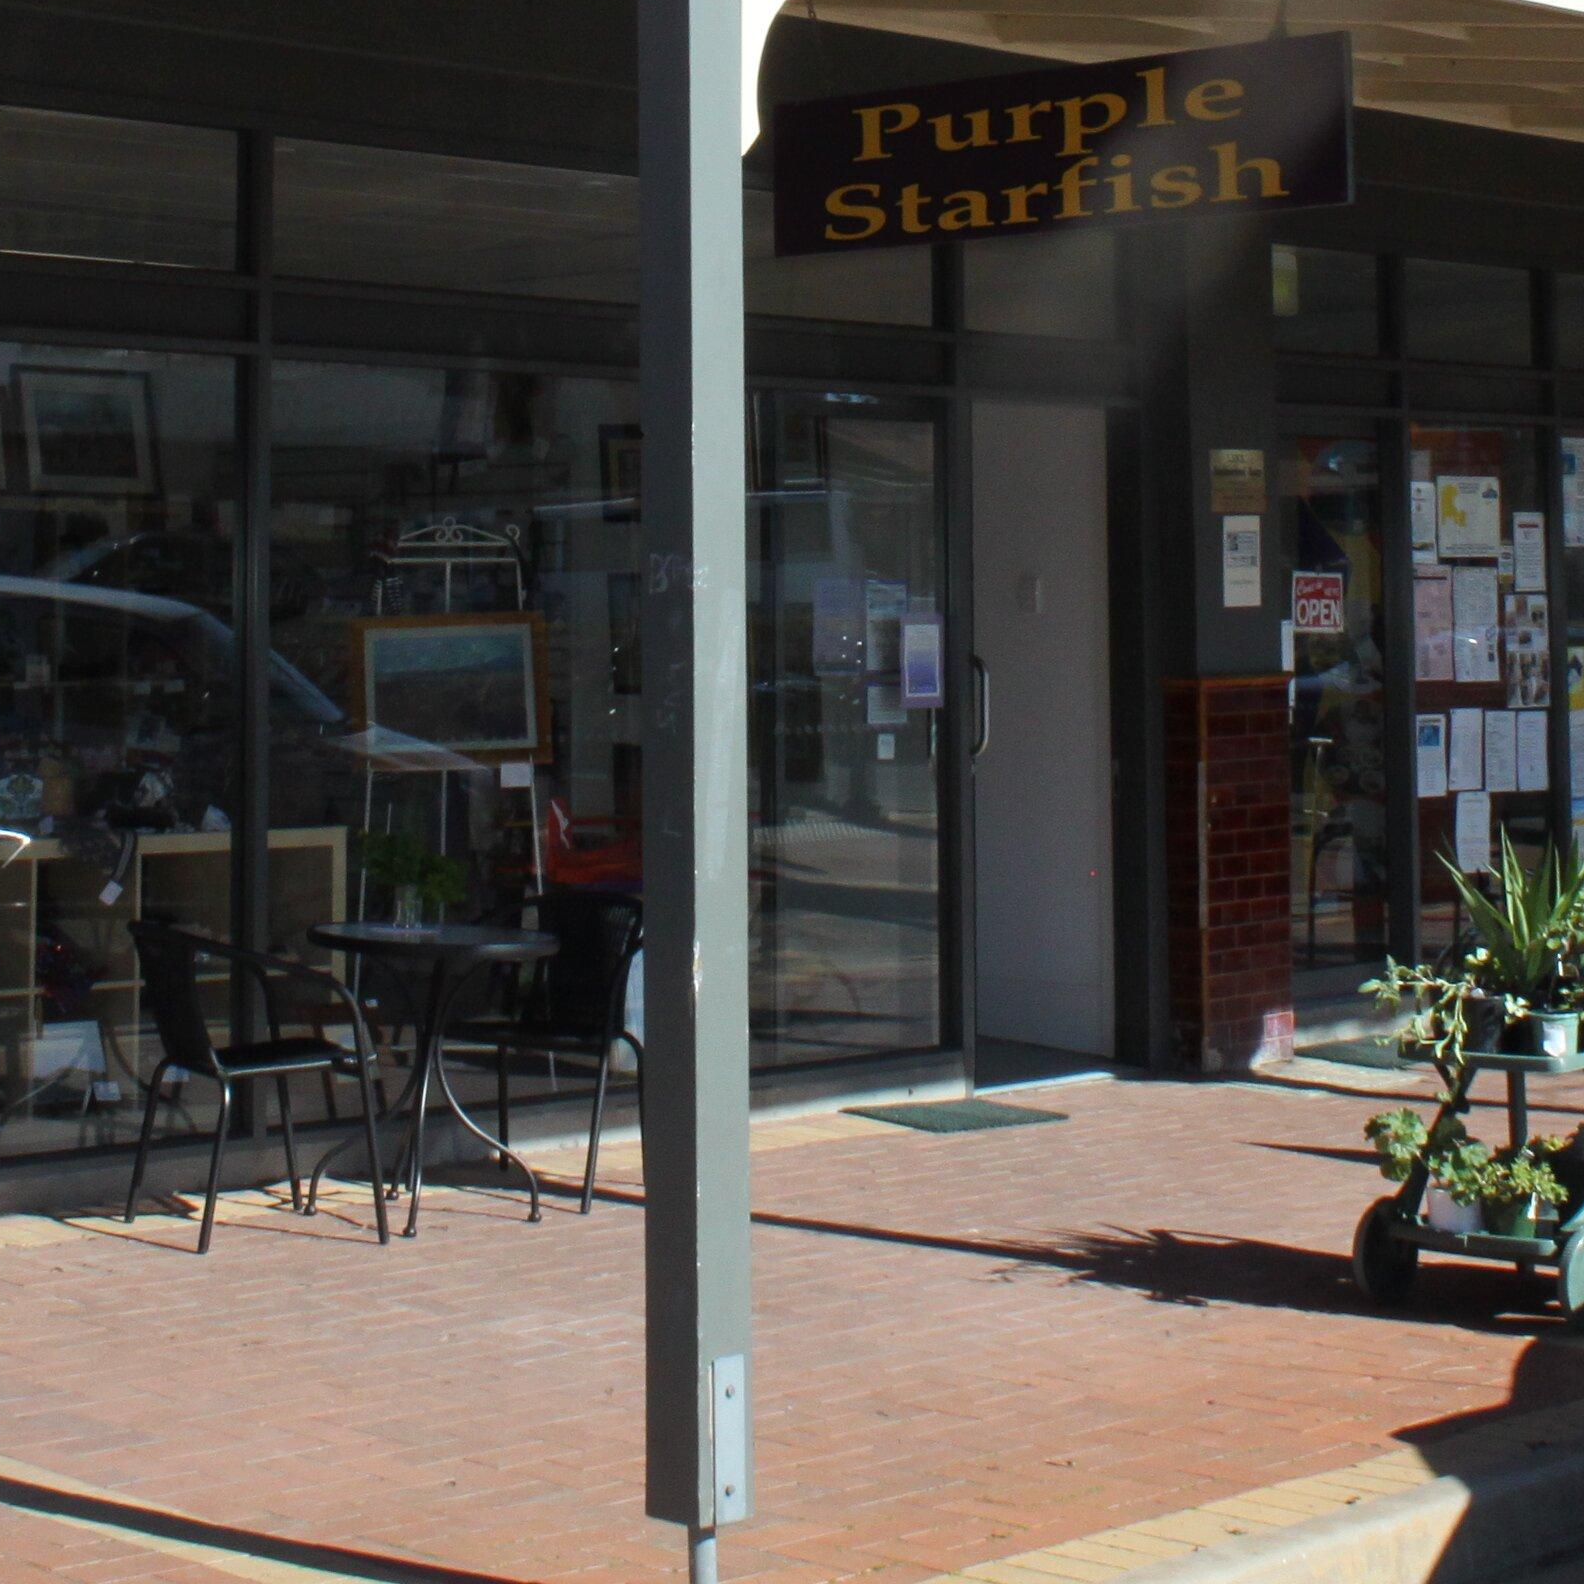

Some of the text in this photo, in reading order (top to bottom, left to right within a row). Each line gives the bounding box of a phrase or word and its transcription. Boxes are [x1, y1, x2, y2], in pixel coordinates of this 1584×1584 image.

[853, 67, 1245, 161] Purple
[824, 141, 1290, 242] Starfish
[1296, 599, 1341, 626] OPEN
